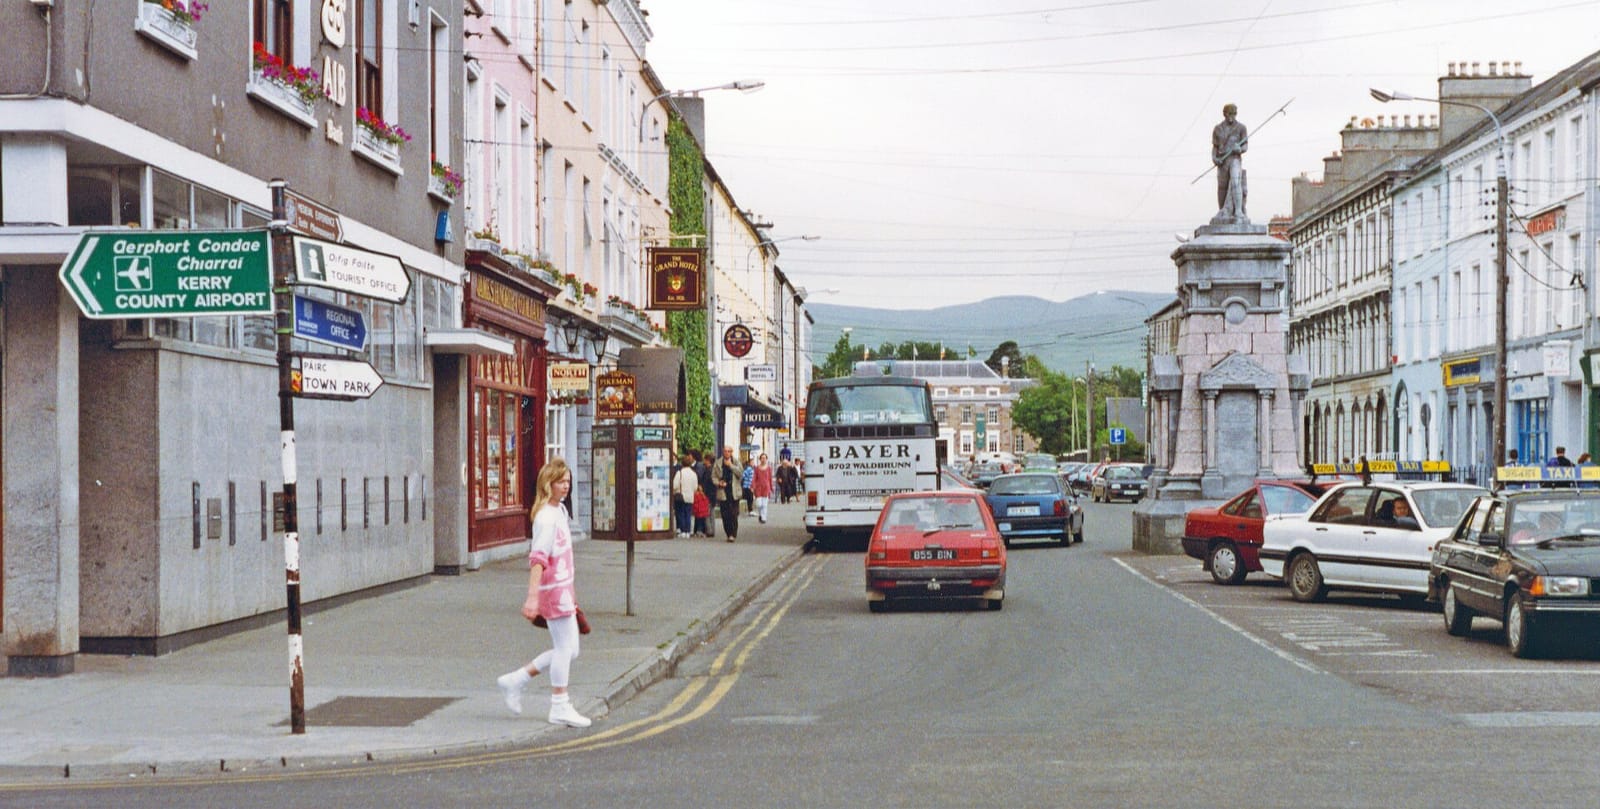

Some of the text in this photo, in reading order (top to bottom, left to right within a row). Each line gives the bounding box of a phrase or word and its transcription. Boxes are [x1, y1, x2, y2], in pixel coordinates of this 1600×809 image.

[322, 55, 346, 107] AIB
[198, 238, 261, 253] Condae
[654, 260, 699, 273] GRAND HOTEL
[178, 275, 233, 291] KERRY
[331, 270, 398, 293] TOURIST OFFICE
[115, 292, 267, 309] COUNTY AIRPORT
[326, 308, 356, 328] REGIONAL
[330, 324, 350, 340] OFFICE
[552, 367, 586, 378] NORTH
[304, 377, 371, 394] TOWN PARK
[600, 378, 634, 386] PIKEMAN
[609, 402, 624, 410] BAR
[745, 413, 773, 423] HOTEL
[828, 444, 910, 459] BAYER
[853, 461, 912, 470] WALDBRUNN
[1401, 461, 1419, 470] TAXI
[1546, 466, 1576, 479] TAXI
[937, 550, 953, 559] BIN
